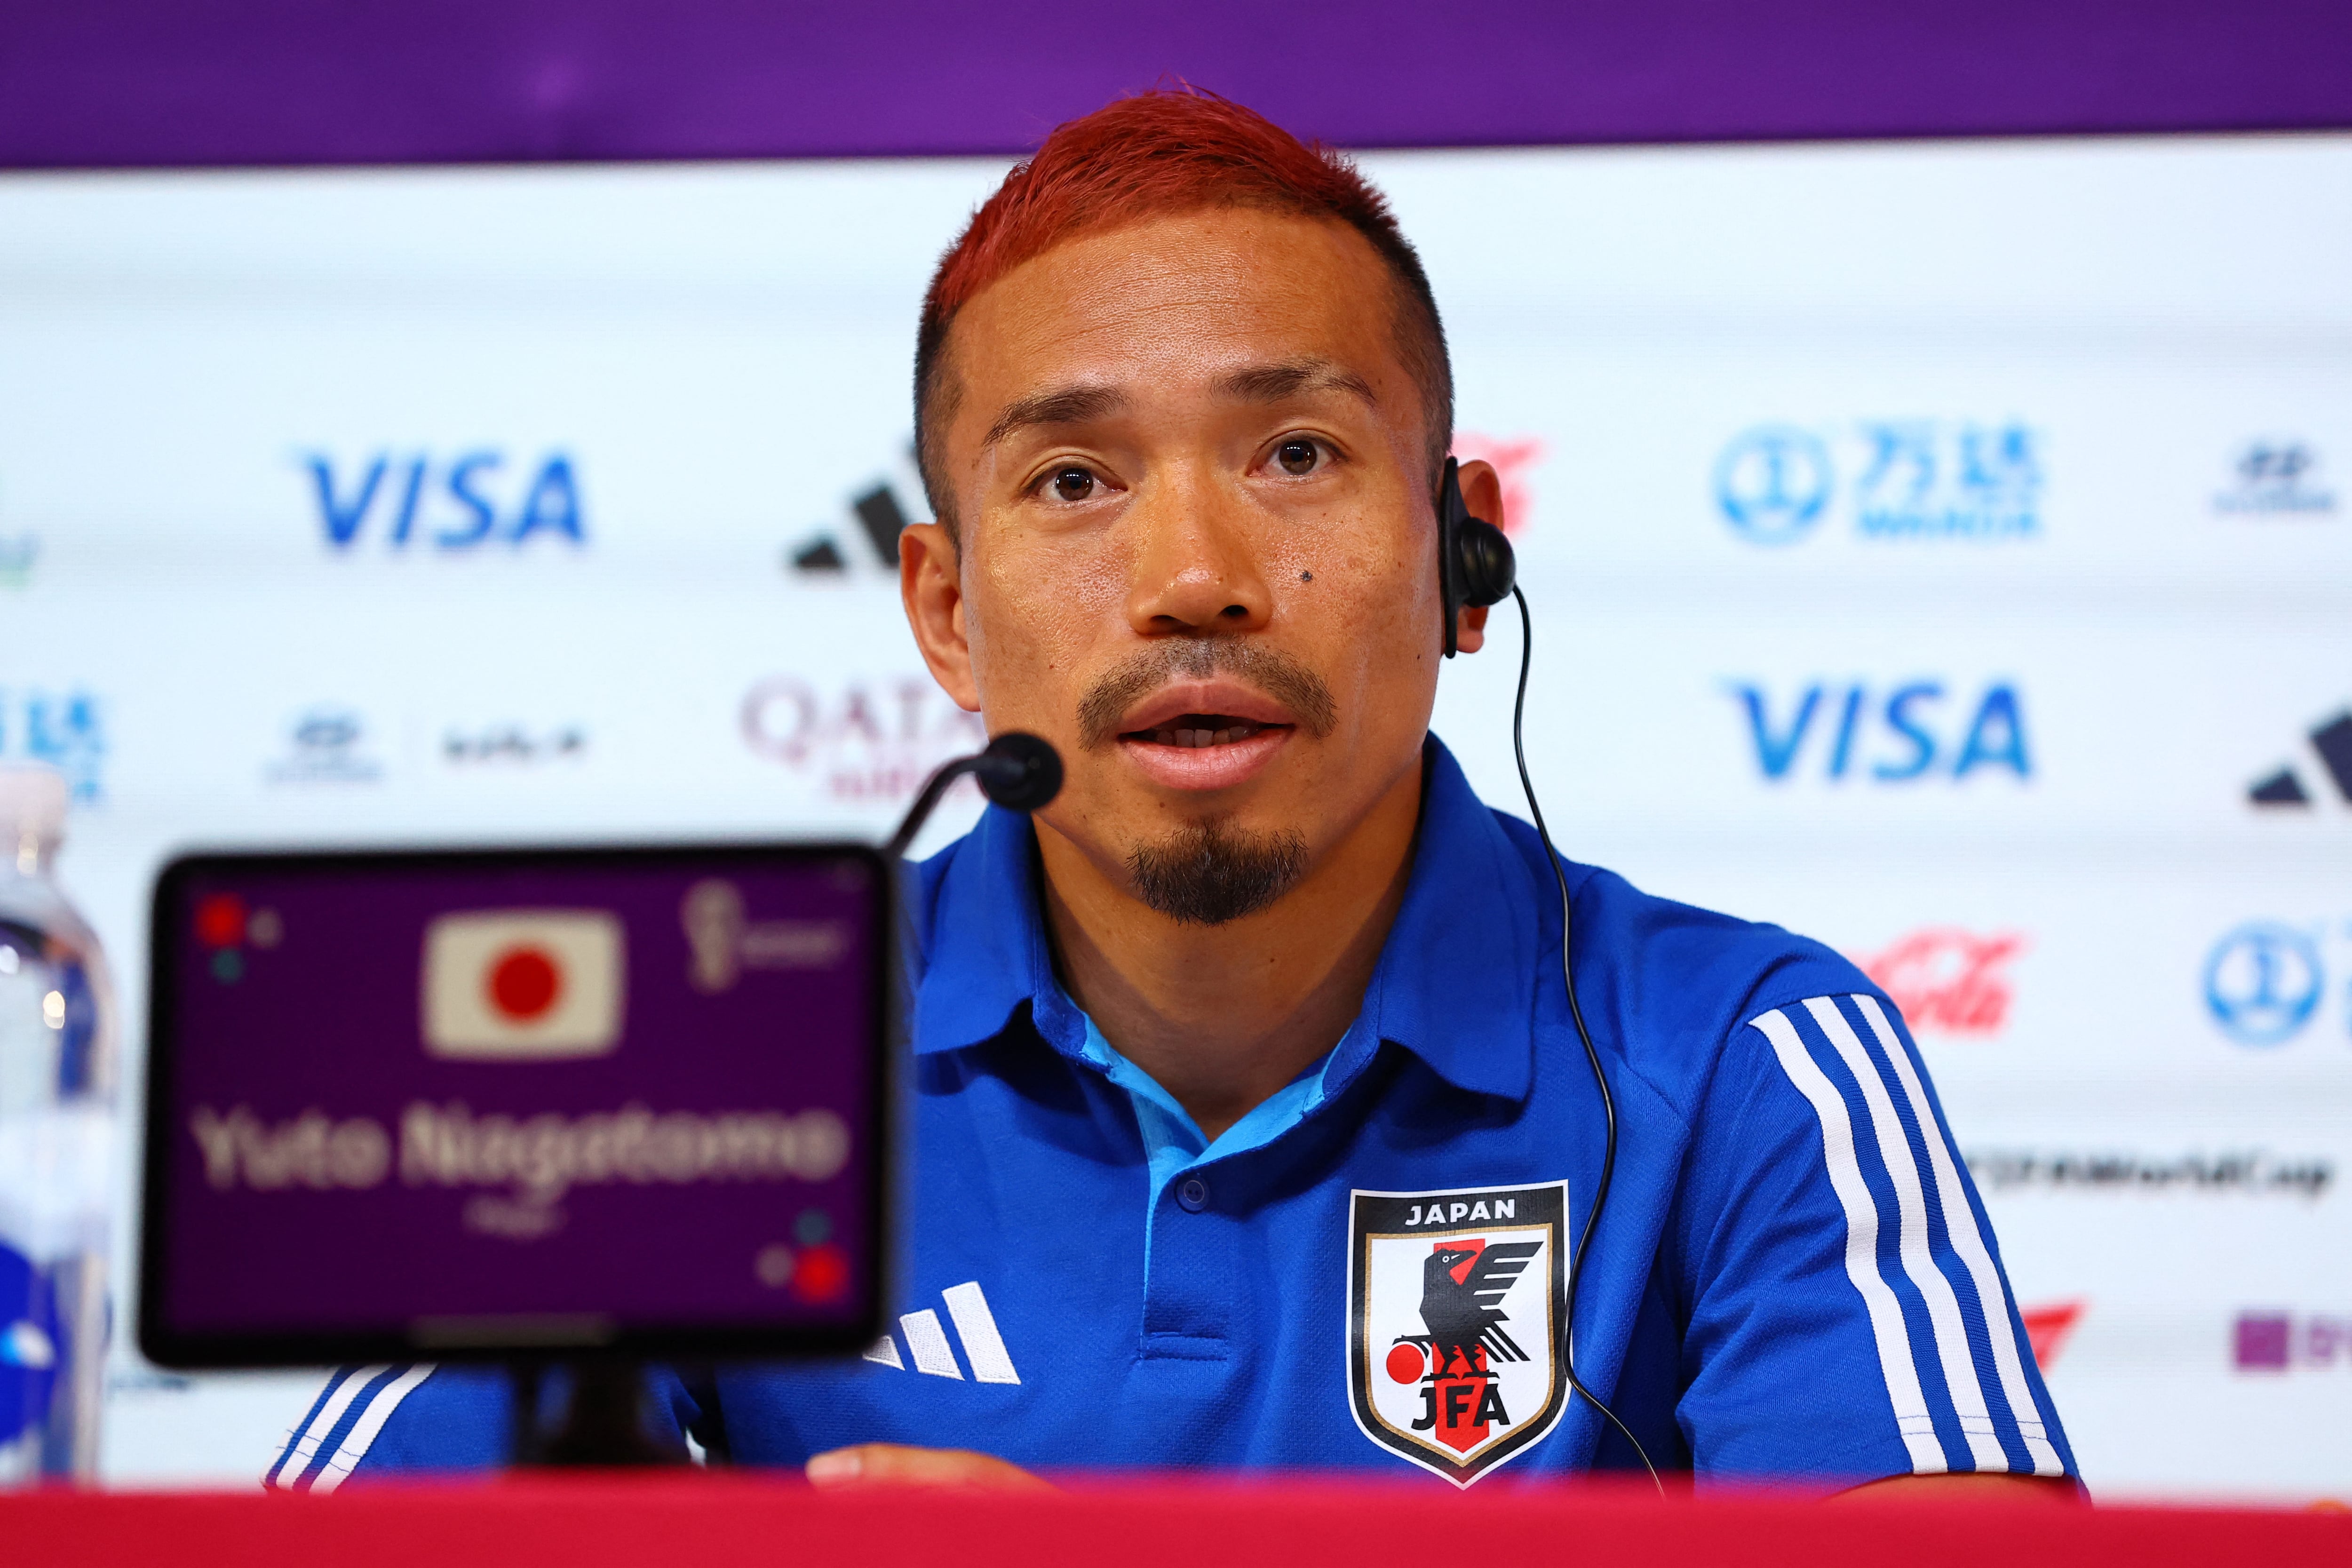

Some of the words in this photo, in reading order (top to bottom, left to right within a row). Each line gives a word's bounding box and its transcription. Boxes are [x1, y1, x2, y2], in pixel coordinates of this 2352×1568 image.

[301, 449, 588, 554] VISA
[1729, 677, 2034, 785] VISA
[193, 1109, 390, 1187] Yuto
[400, 1105, 847, 1202] Nagatomo
[1405, 1199, 1515, 1226] JAPAN
[1411, 1383, 1510, 1431] JFA
